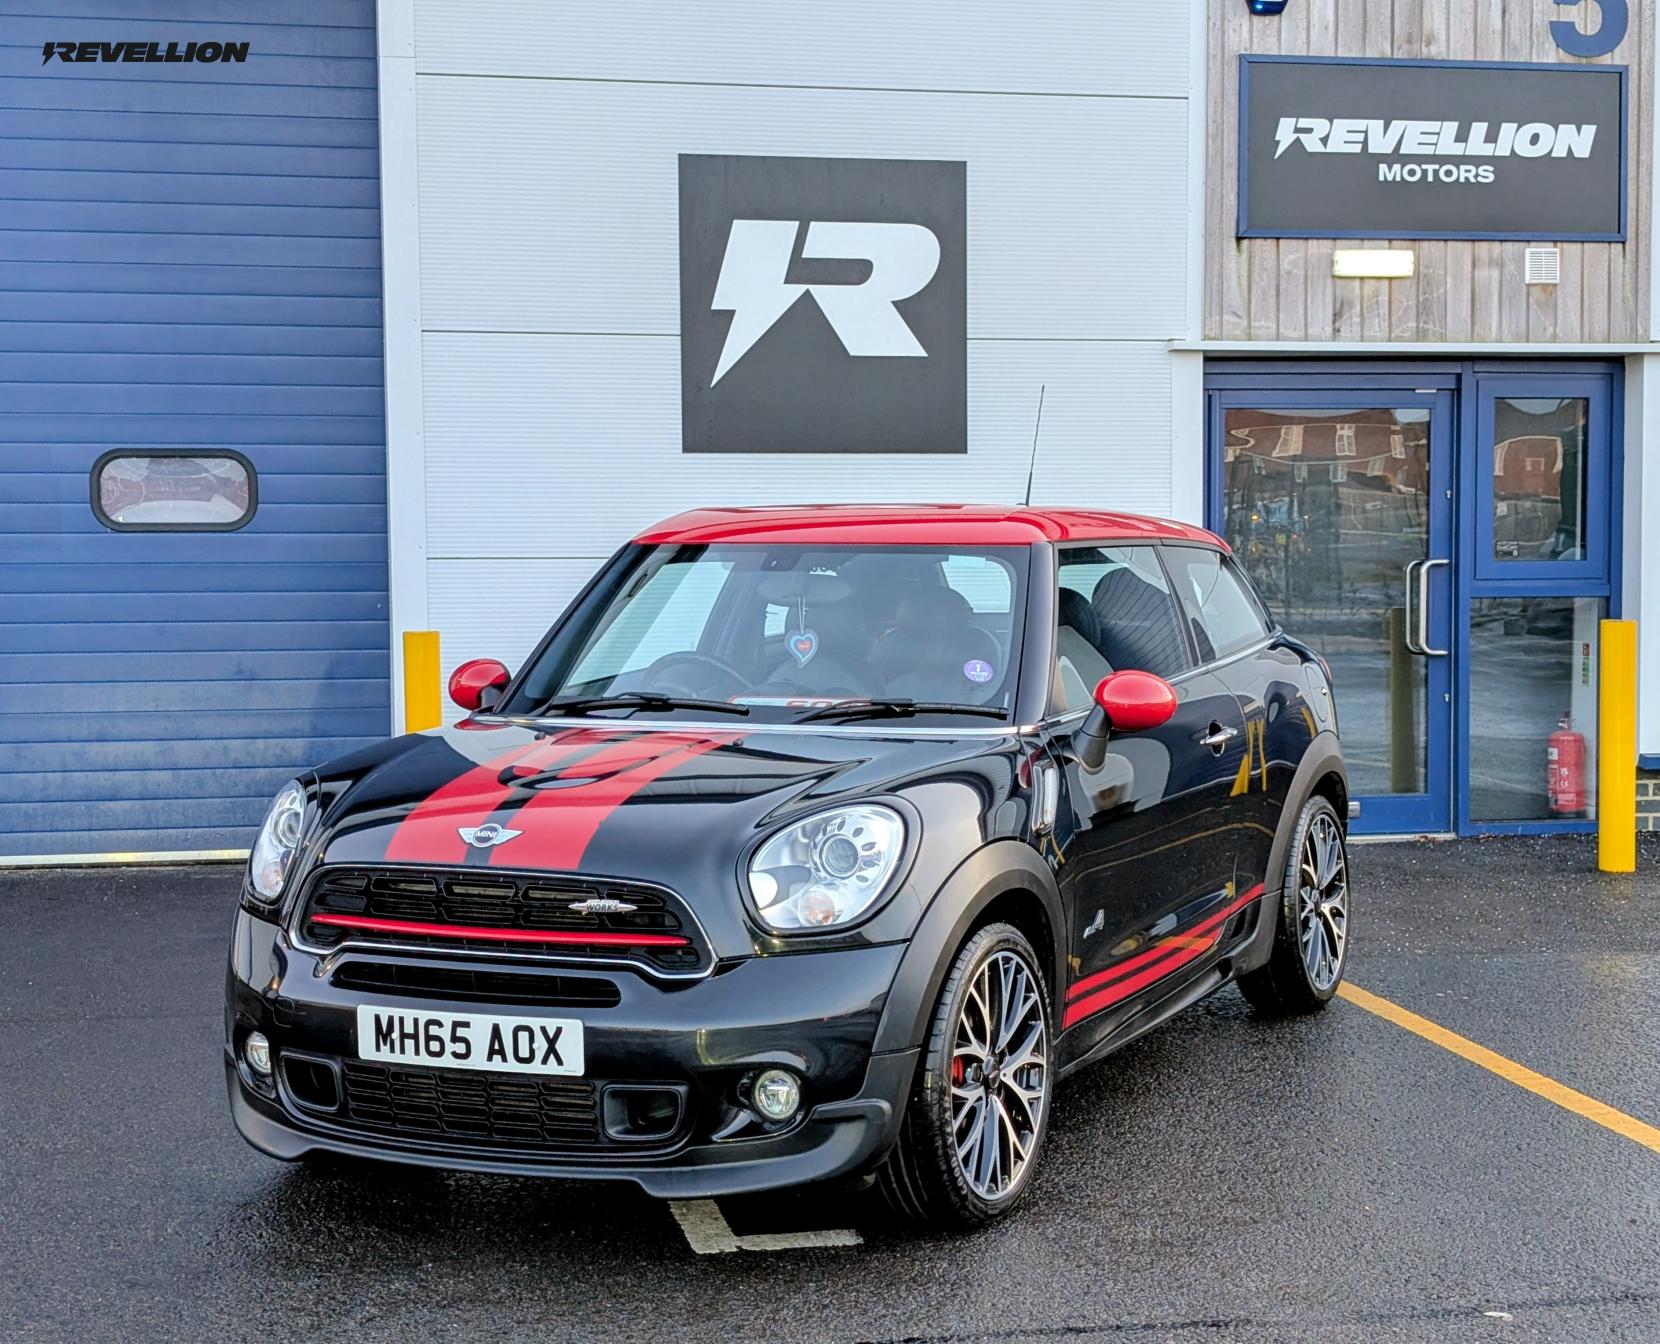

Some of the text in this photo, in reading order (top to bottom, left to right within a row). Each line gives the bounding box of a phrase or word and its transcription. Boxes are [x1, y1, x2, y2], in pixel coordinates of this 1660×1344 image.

[1274, 117, 1597, 159] REVELLION
[1378, 163, 1495, 183] MOTORS
[710, 219, 941, 388] R
[475, 830, 499, 839] MINI
[586, 903, 618, 911] WORKS
[374, 1013, 472, 1060] MH65
